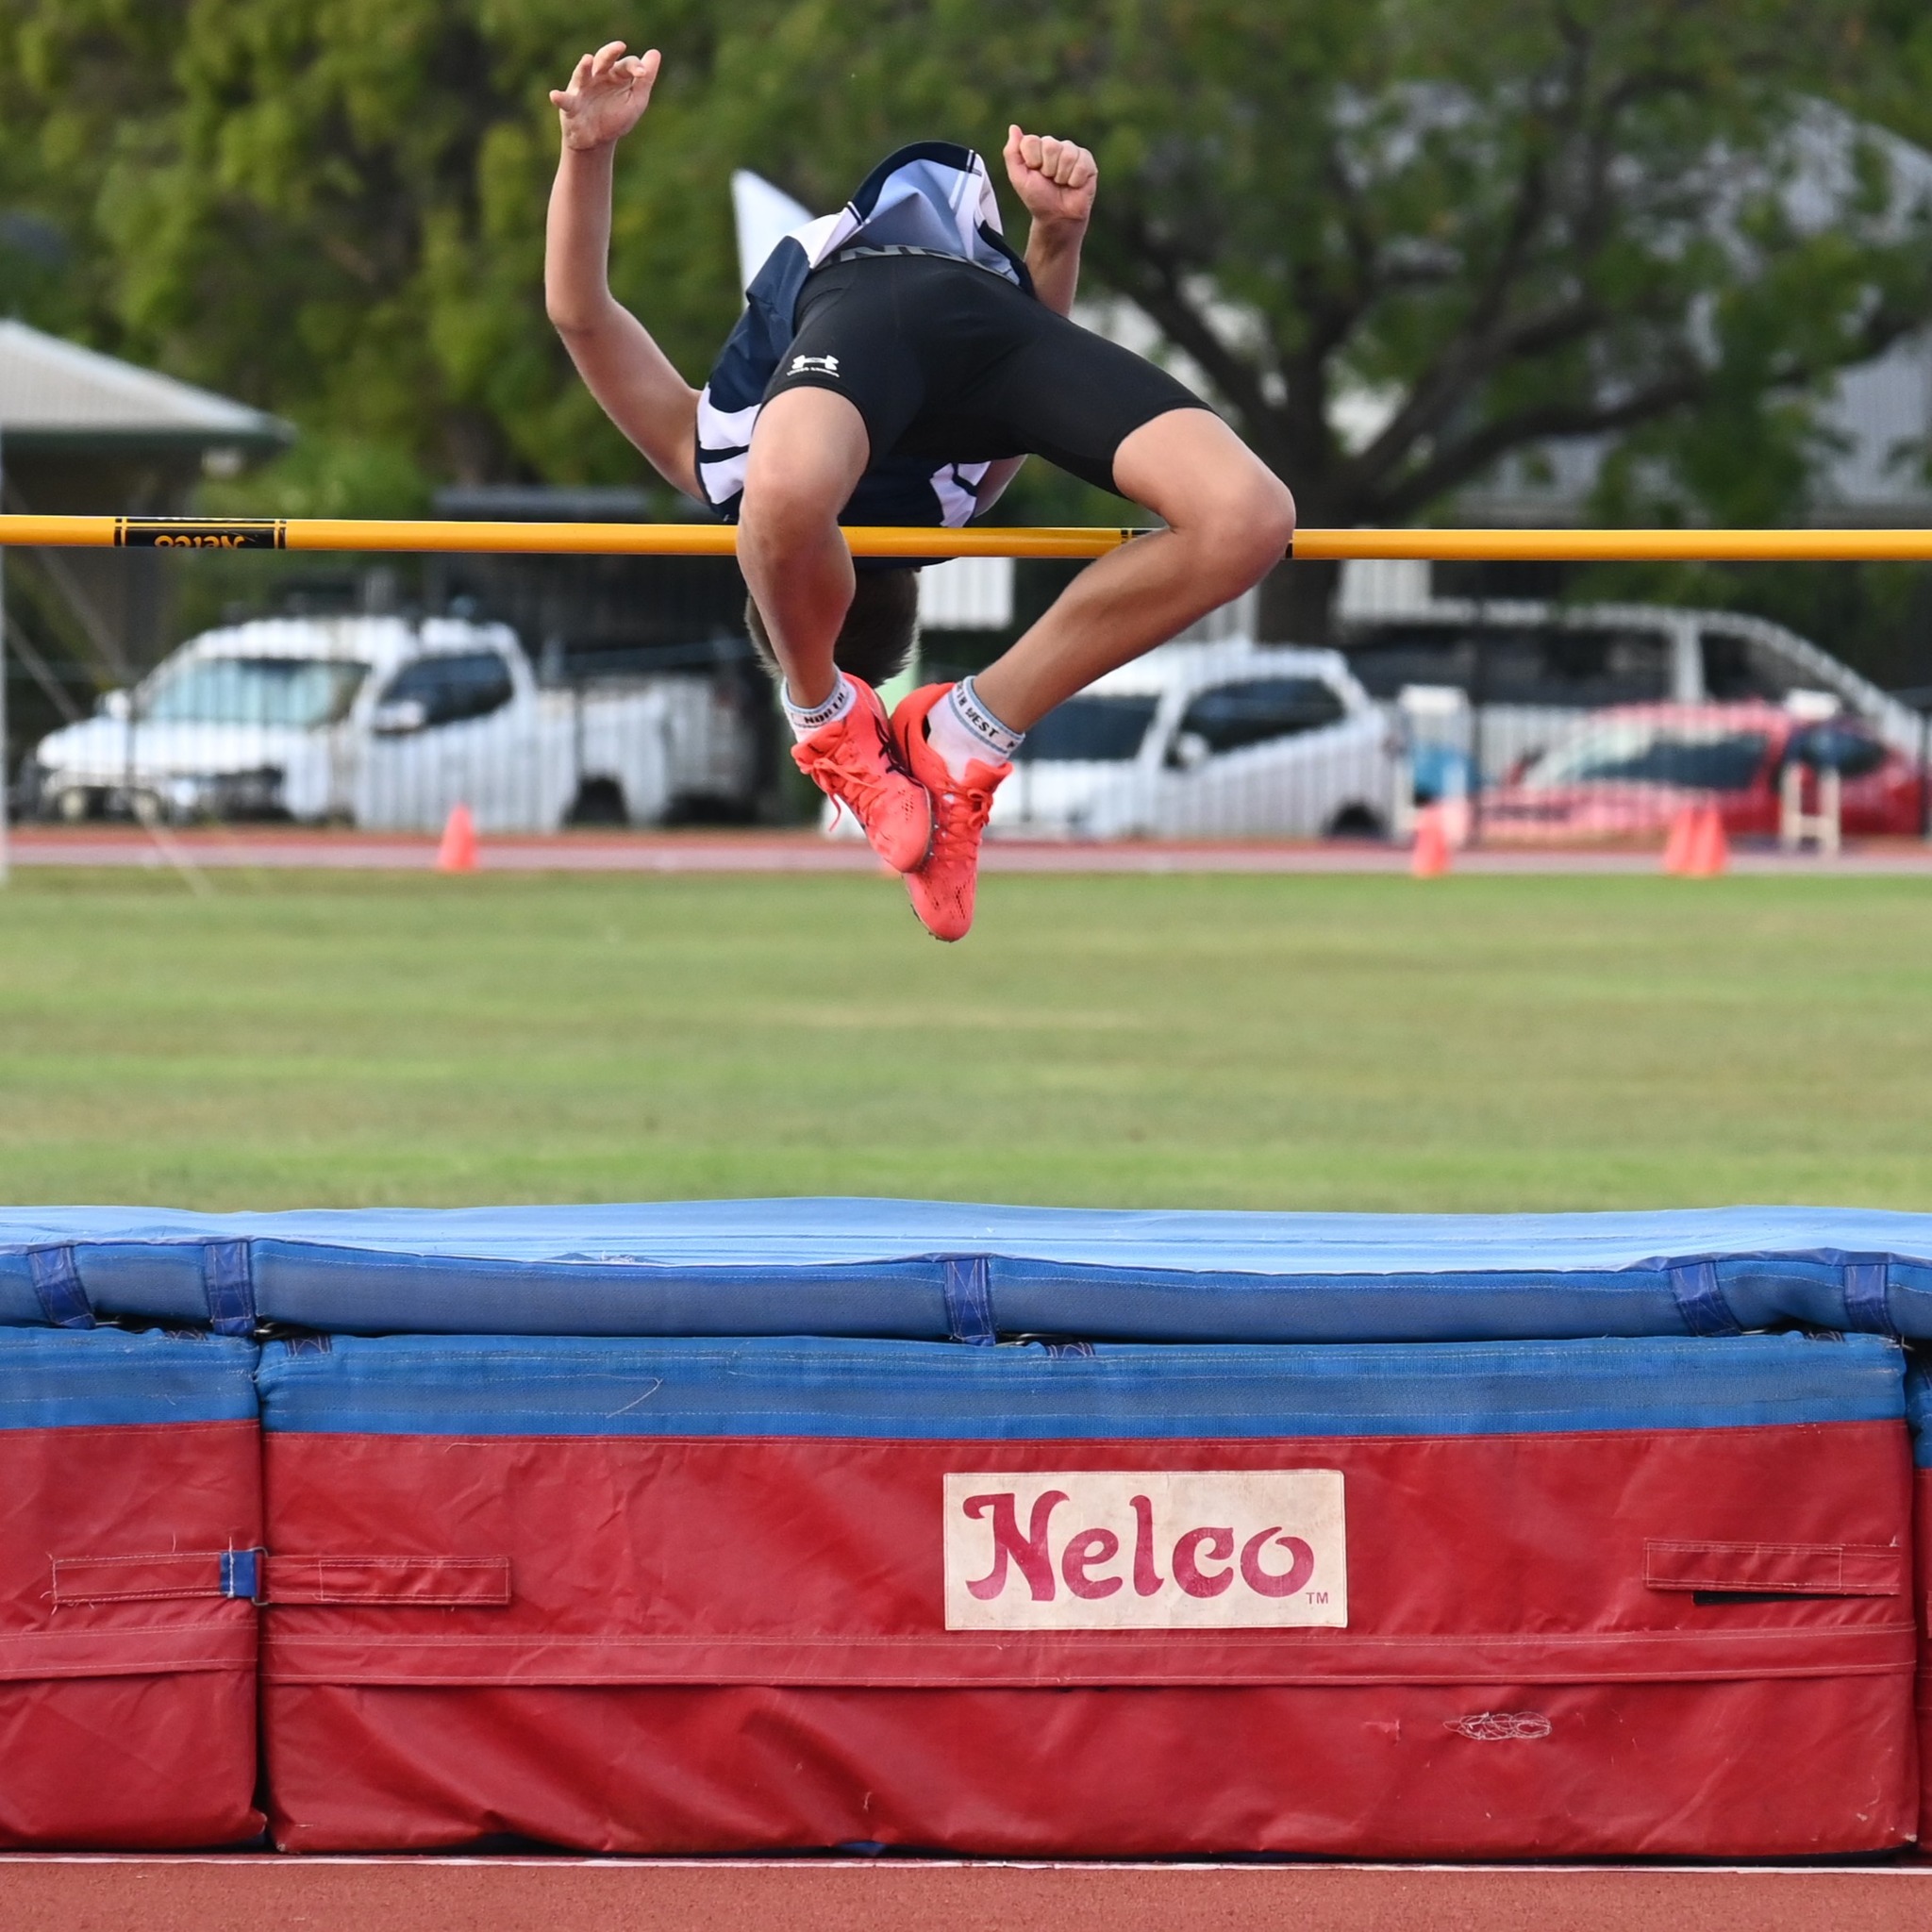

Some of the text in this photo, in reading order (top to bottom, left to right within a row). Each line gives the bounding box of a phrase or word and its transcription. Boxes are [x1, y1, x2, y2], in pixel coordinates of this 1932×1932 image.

[965, 707, 1000, 738] WEST
[962, 1490, 1329, 1605] Nelco TM
